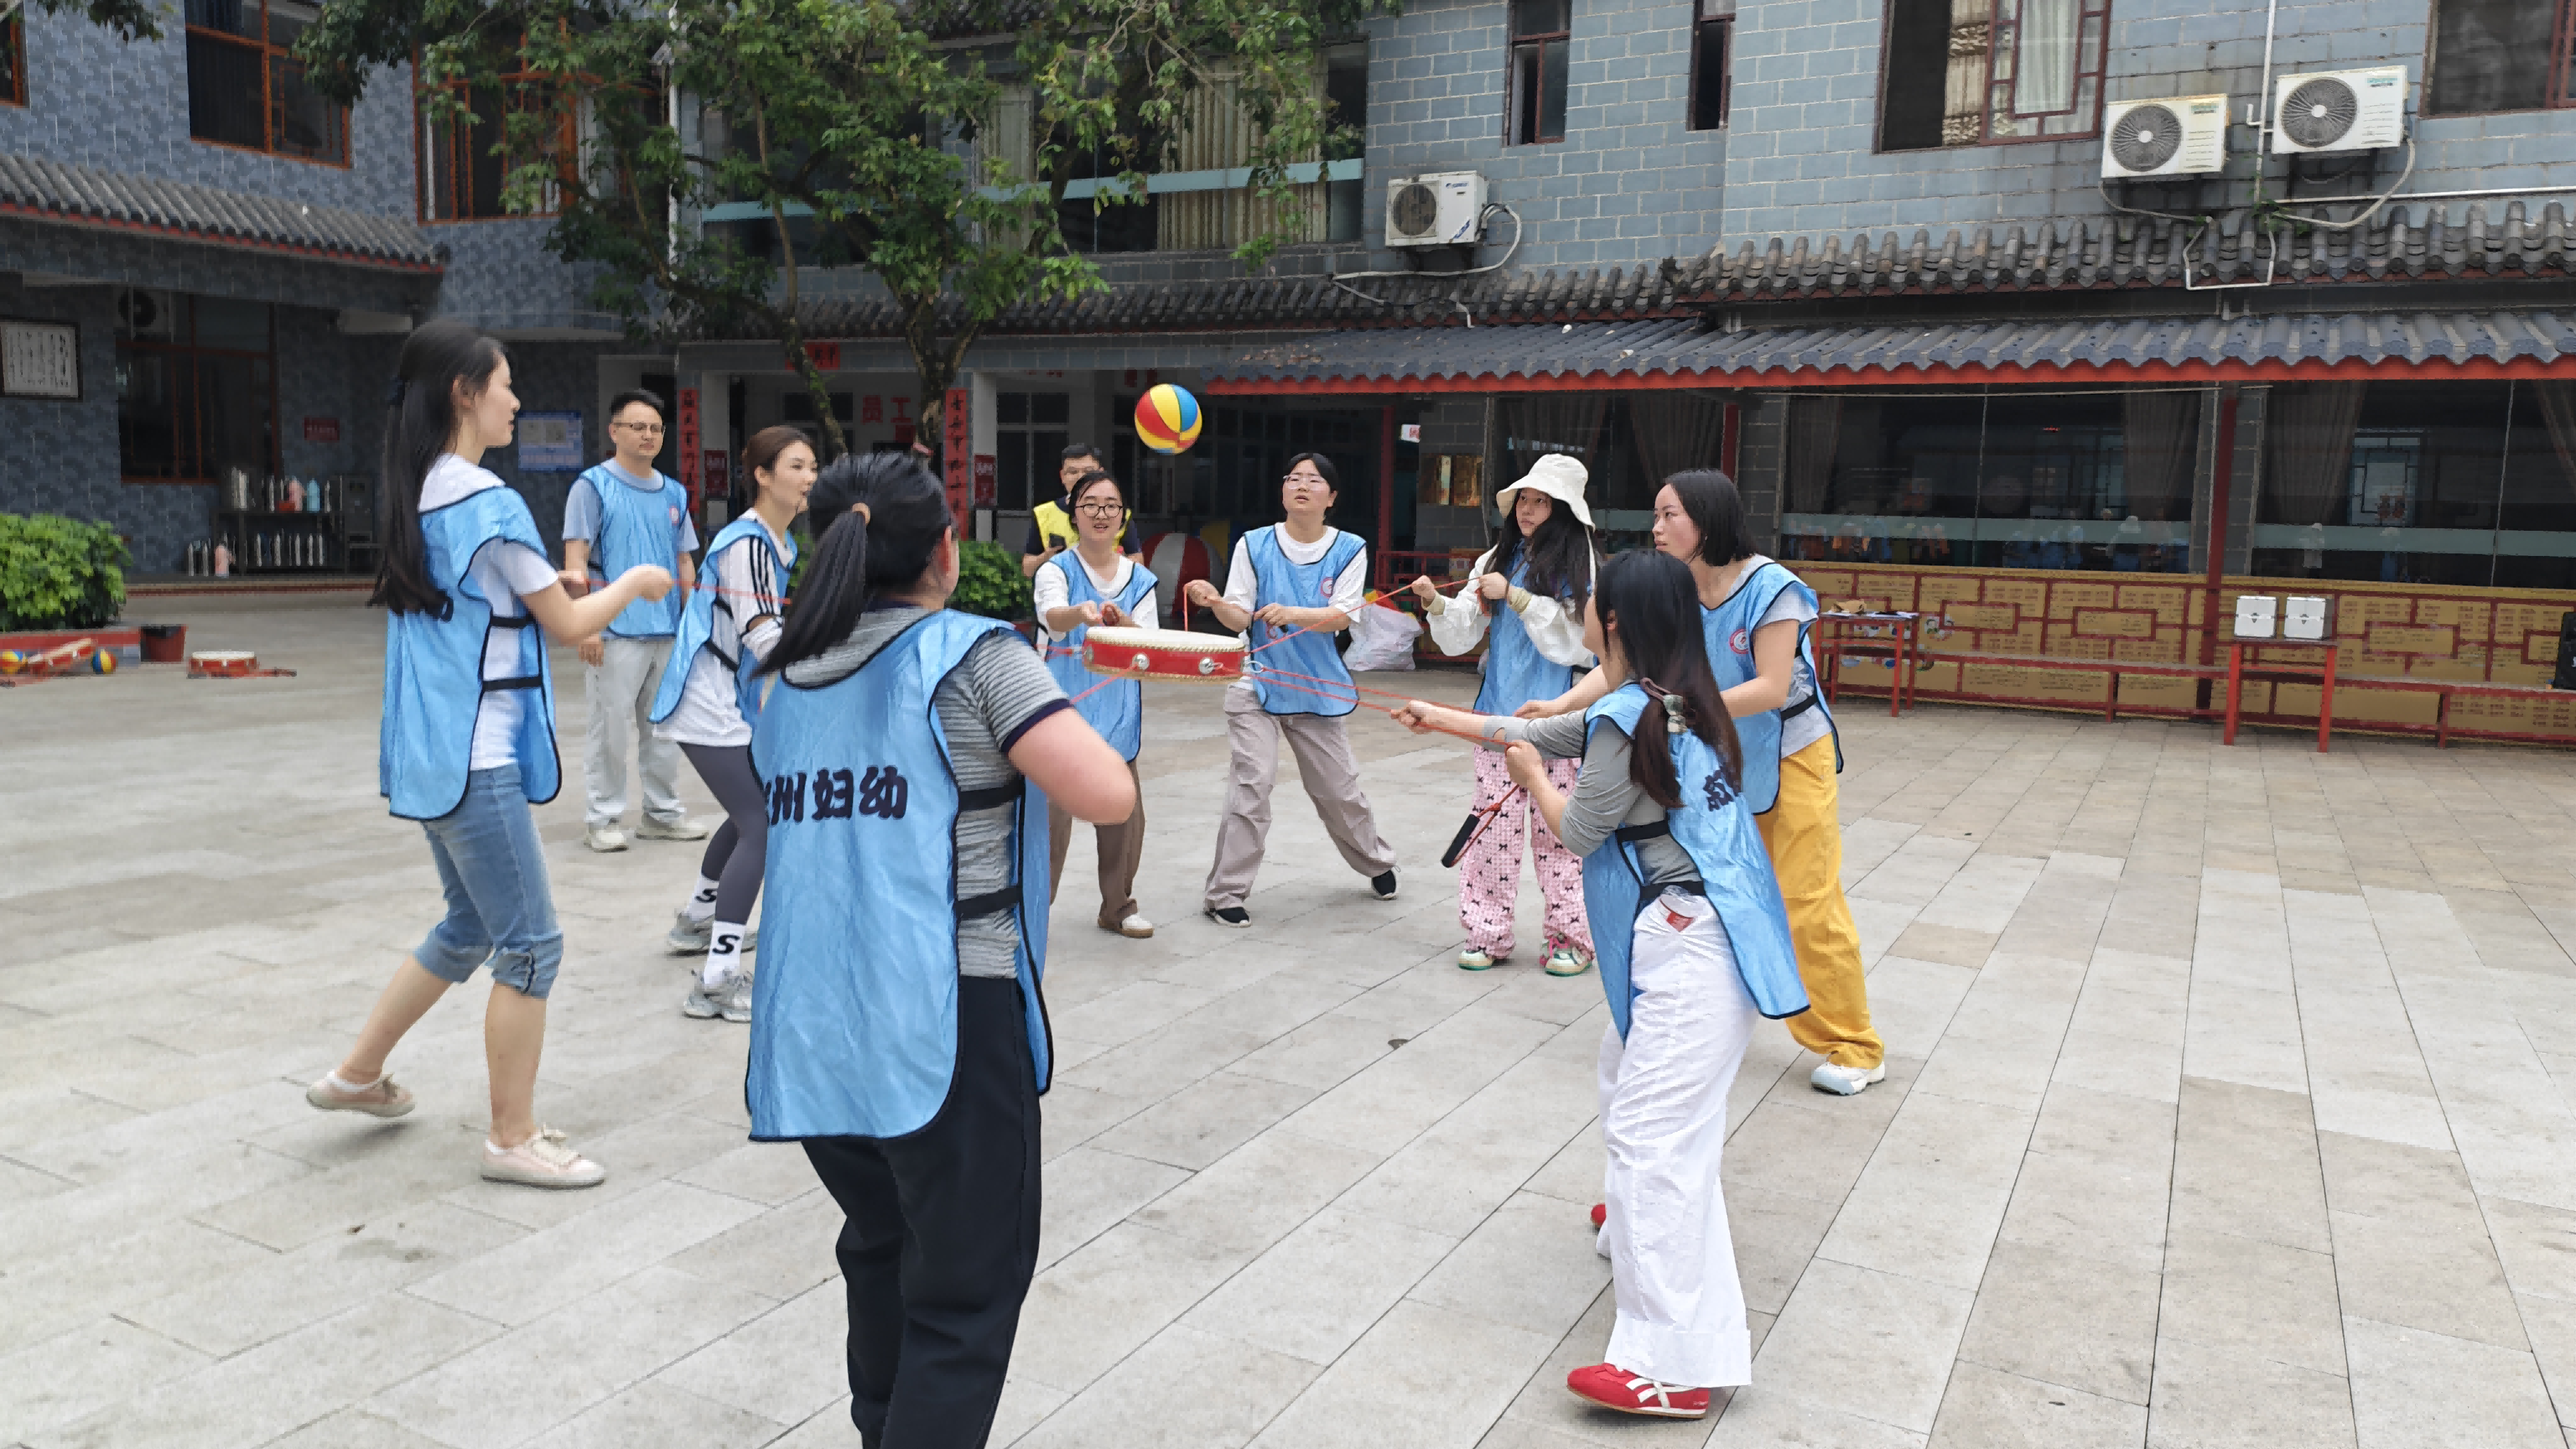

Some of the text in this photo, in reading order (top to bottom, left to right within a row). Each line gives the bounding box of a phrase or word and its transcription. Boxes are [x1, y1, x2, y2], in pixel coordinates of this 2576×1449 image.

[765, 765, 908, 827] 州妇幼
[695, 888, 718, 903] S
[712, 933, 741, 955] S
